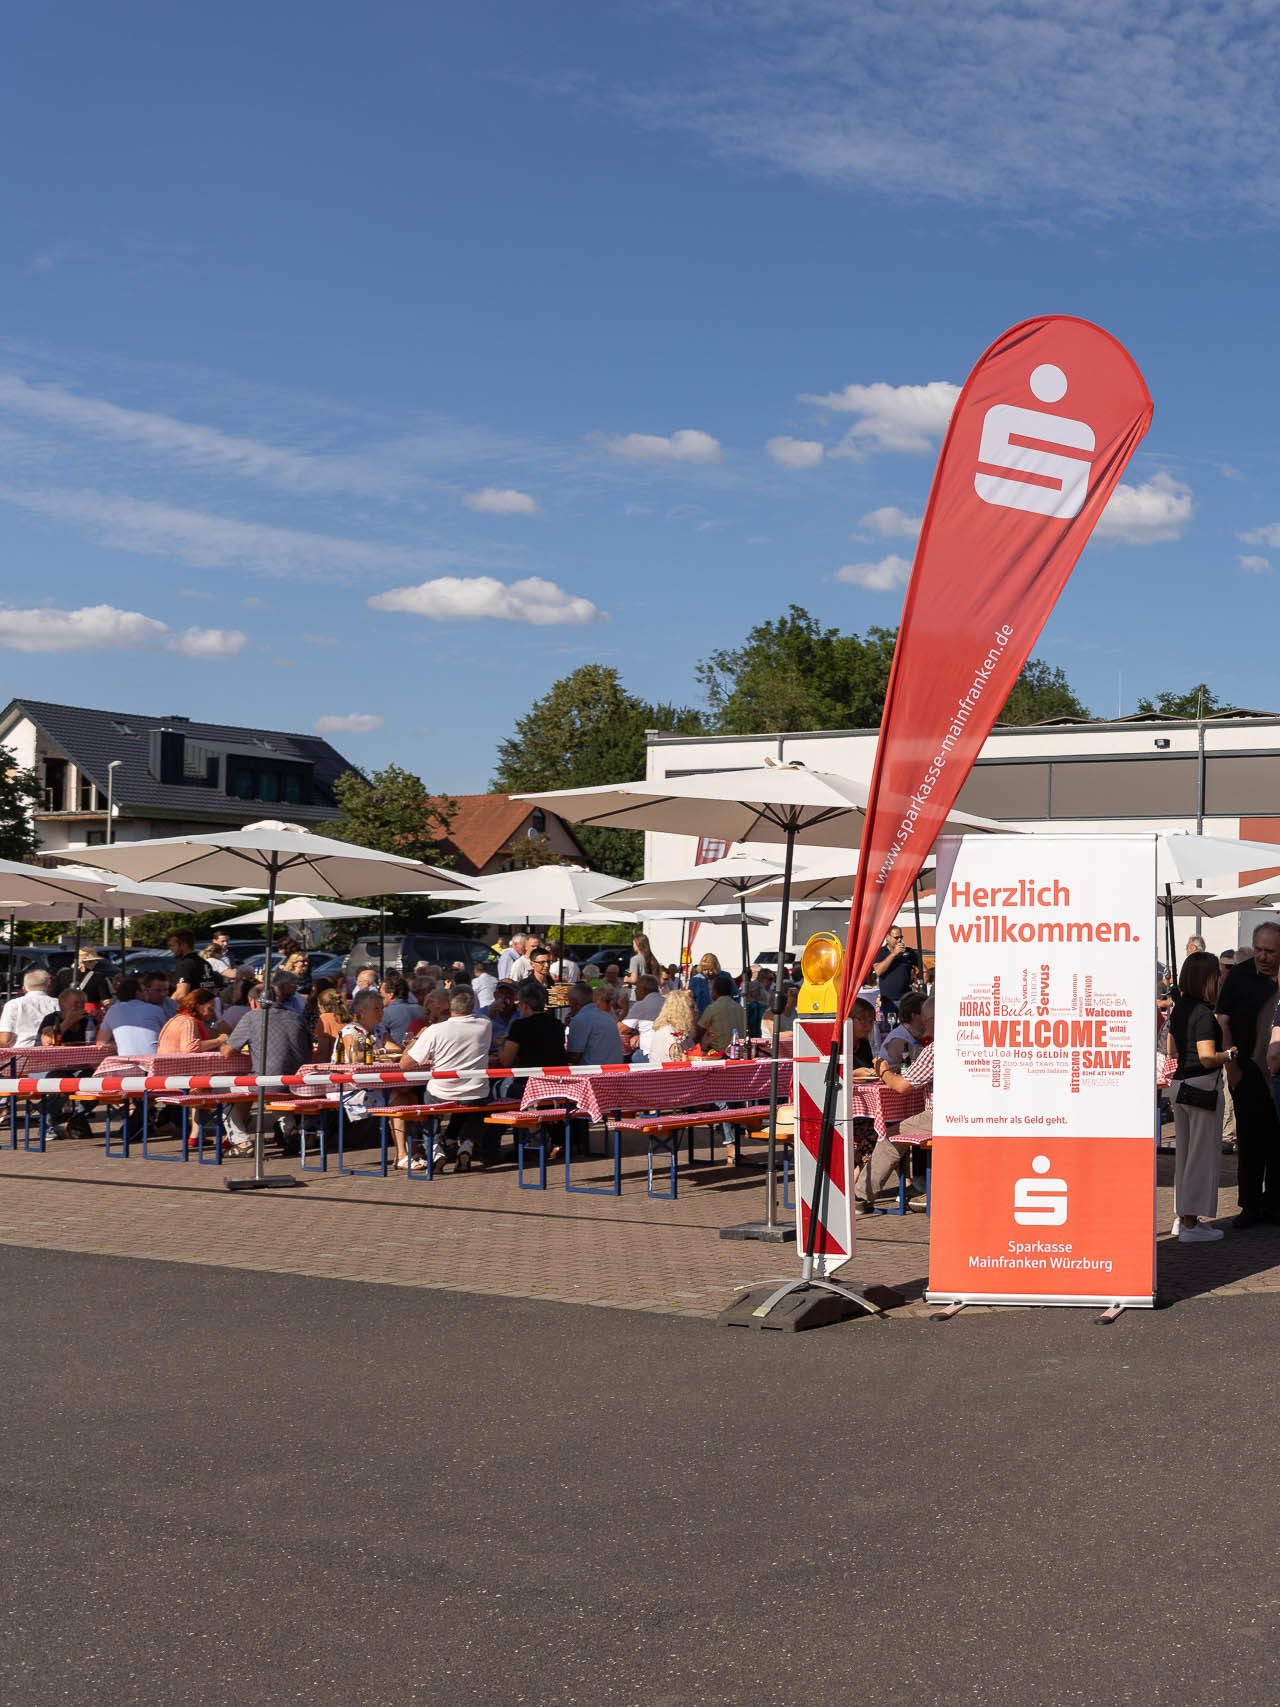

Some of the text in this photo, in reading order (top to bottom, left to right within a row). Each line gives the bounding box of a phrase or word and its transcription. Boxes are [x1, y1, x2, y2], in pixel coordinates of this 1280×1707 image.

[875, 623, 1014, 885] www.sparkasse-mainfranken.de
[951, 879, 1071, 907] Herzlich
[948, 915, 1141, 943] willkommen.
[992, 975, 1001, 1016] merhbe
[1036, 964, 1050, 1017] Servus
[959, 1001, 991, 1016] HORAS
[1001, 1001, 1035, 1017] Bula
[981, 1019, 1107, 1048] WELCOME
[955, 1048, 1011, 1057] Tervetuloa
[1082, 1050, 1131, 1069] SALVE
[991, 1059, 1001, 1088] CROESO
[985, 1116, 1008, 1124] mehr
[1010, 1116, 1023, 1124] als
[1024, 1116, 1044, 1124] Geld
[1046, 1116, 1068, 1126] geht.
[1008, 1240, 1073, 1255] Sparkasse
[968, 1256, 1113, 1272] Mainfranken Würzburg
